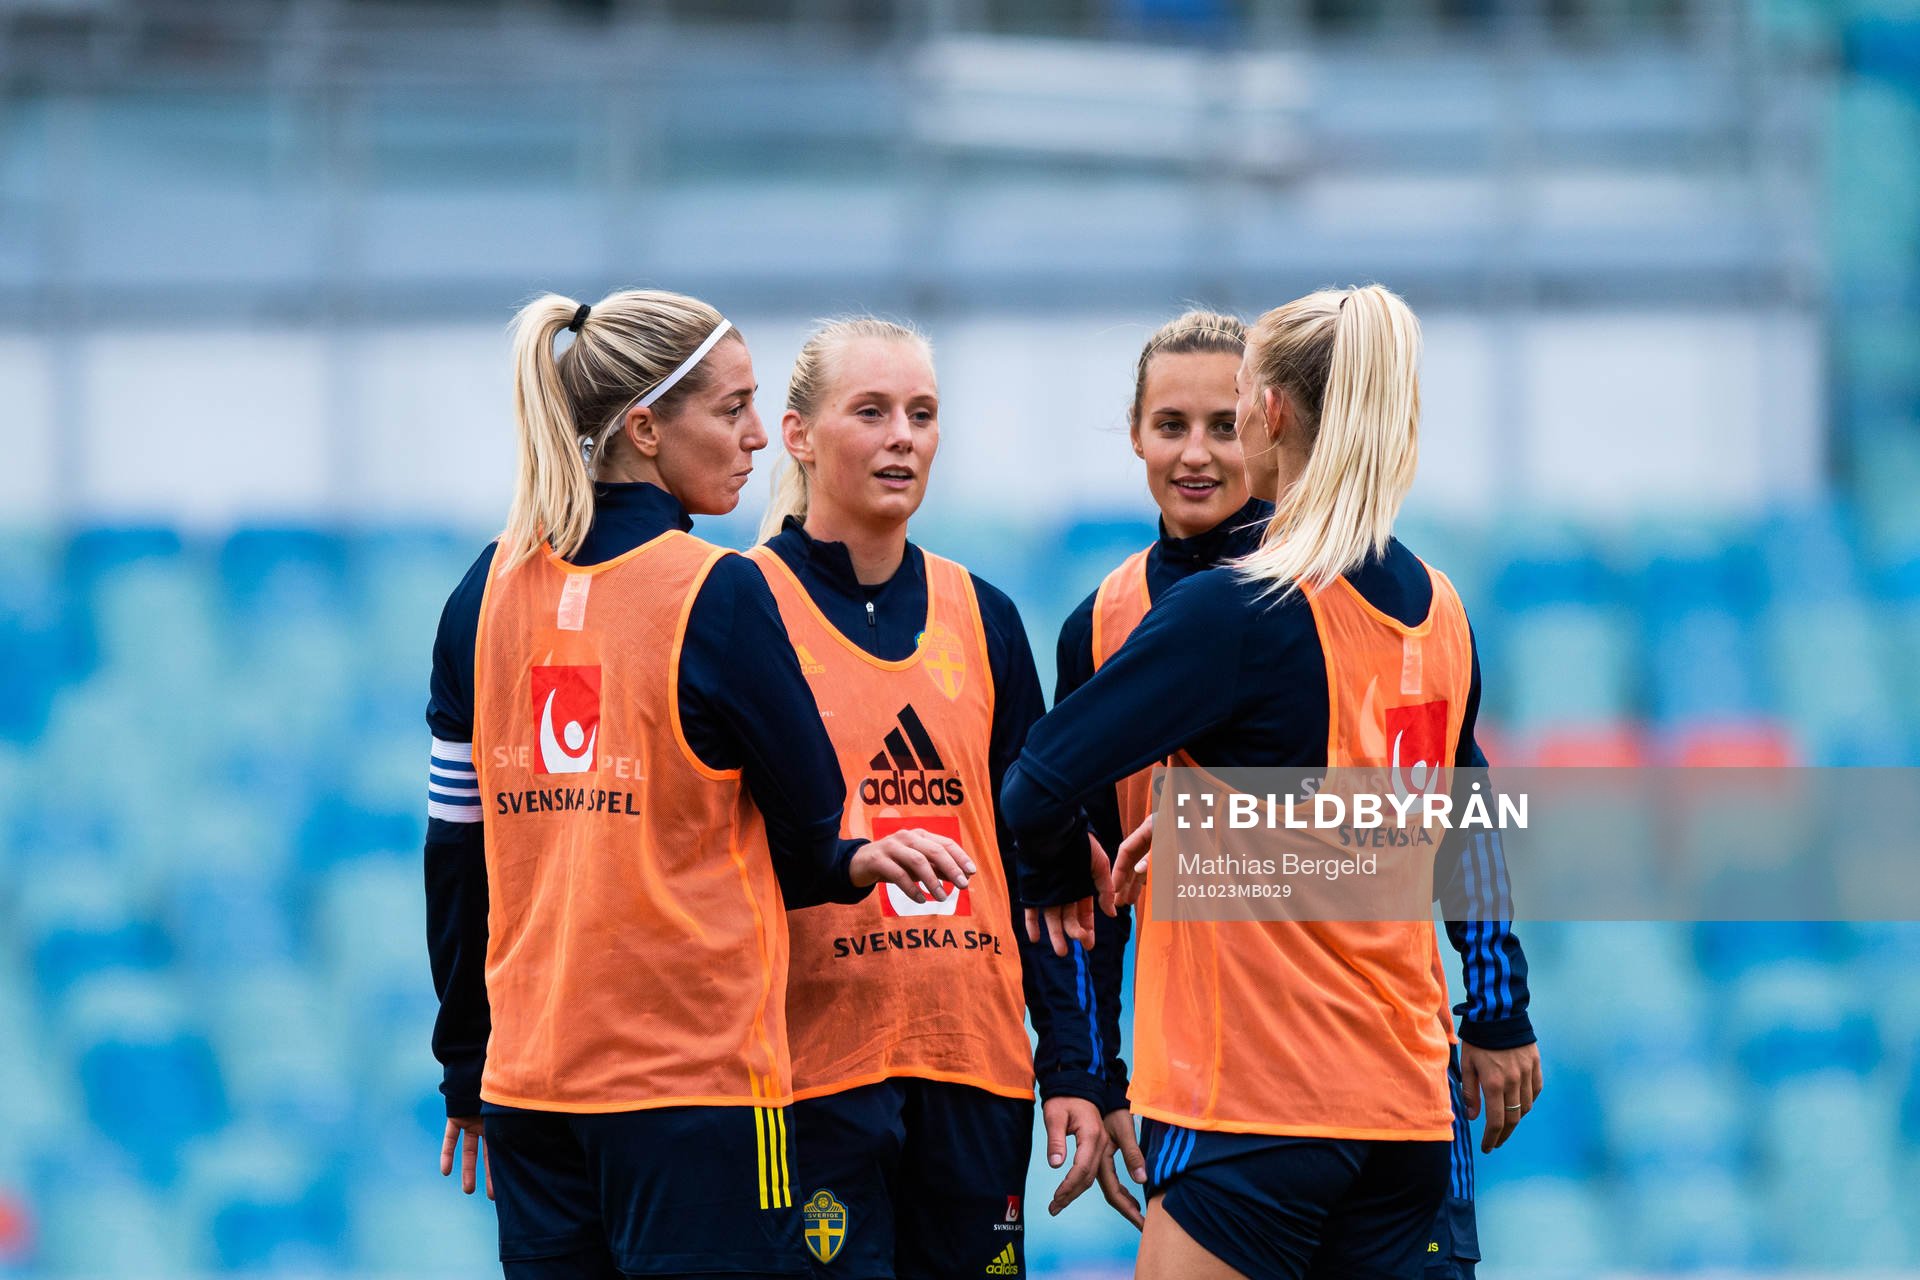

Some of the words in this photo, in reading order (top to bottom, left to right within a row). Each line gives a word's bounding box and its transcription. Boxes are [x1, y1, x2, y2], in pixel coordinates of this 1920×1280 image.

[497, 788, 585, 815] SVENSKA
[587, 789, 640, 815] SPEL
[859, 770, 964, 805] adidas
[833, 928, 957, 958] SVENSKA
[986, 1263, 1018, 1275] adidas
